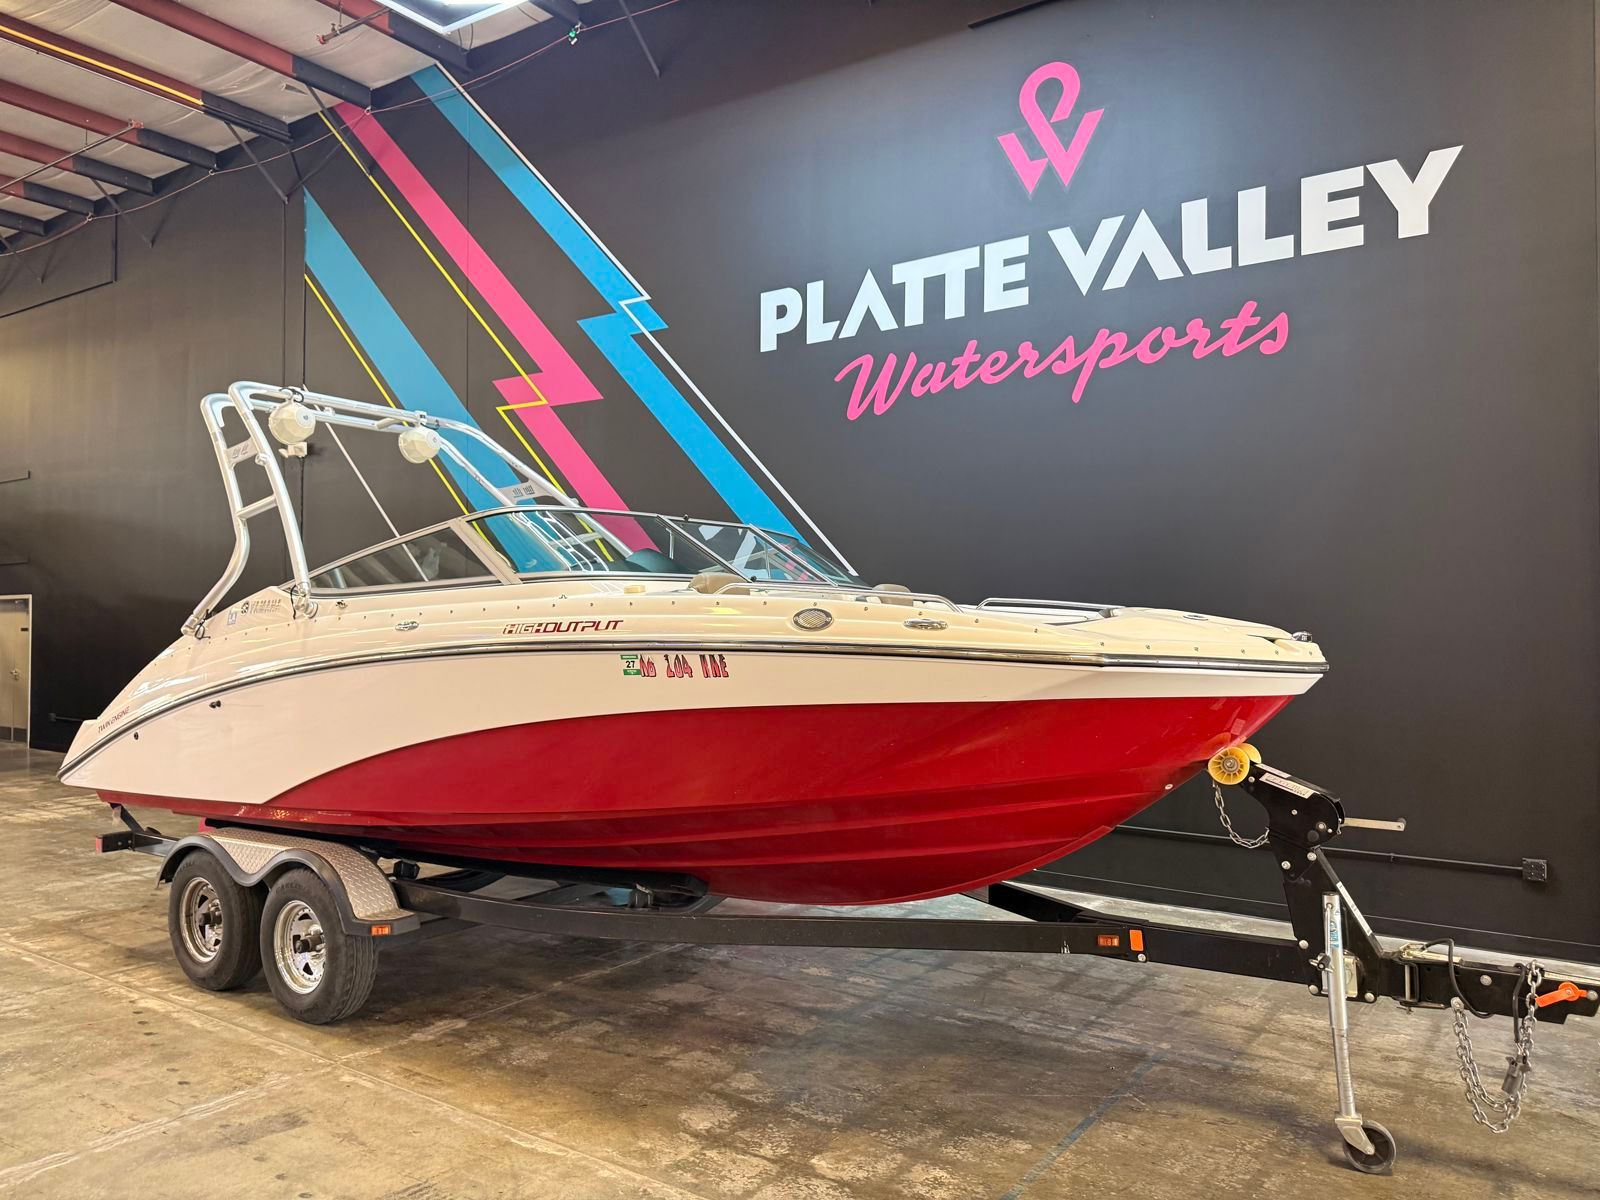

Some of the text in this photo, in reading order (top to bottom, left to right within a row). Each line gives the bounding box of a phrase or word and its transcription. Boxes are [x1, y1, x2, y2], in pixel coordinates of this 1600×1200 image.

[760, 145, 1464, 352] PLATTE VALLEY
[834, 301, 1289, 420] Watersports
[625, 660, 636, 668] 27
